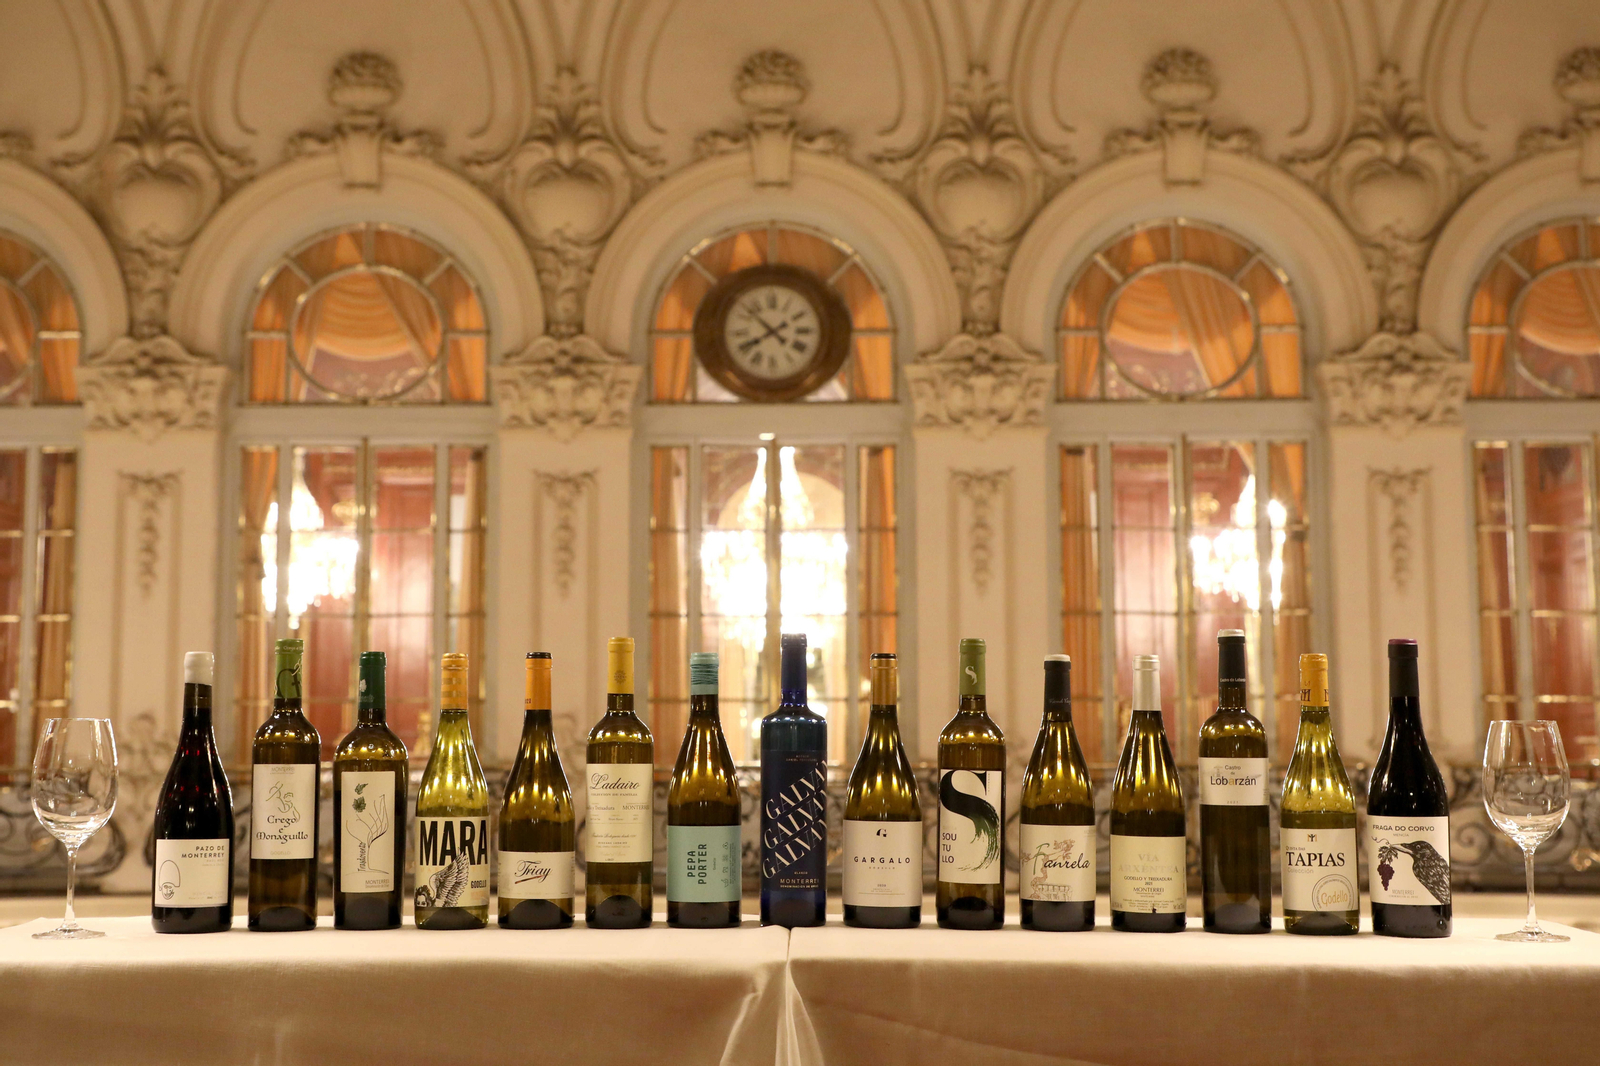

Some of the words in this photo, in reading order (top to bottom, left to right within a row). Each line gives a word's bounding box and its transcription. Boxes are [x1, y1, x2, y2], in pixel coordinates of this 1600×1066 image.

[589, 772, 641, 790] Ladairo
[1210, 775, 1257, 786] Lobarzán
[267, 814, 296, 828] Crego
[256, 831, 309, 845] Monaguillo
[419, 819, 488, 867] MARA
[942, 832, 957, 842] SOU
[942, 843, 952, 853] TU
[686, 850, 696, 878] PEPA
[697, 843, 708, 885] PORTER
[853, 855, 911, 864] GARGALO
[941, 855, 955, 864] LLO
[1032, 842, 1091, 876] Fanrela
[1285, 851, 1346, 867] TAPIAS
[514, 859, 554, 884] Triay
[1320, 890, 1349, 907] Godello
